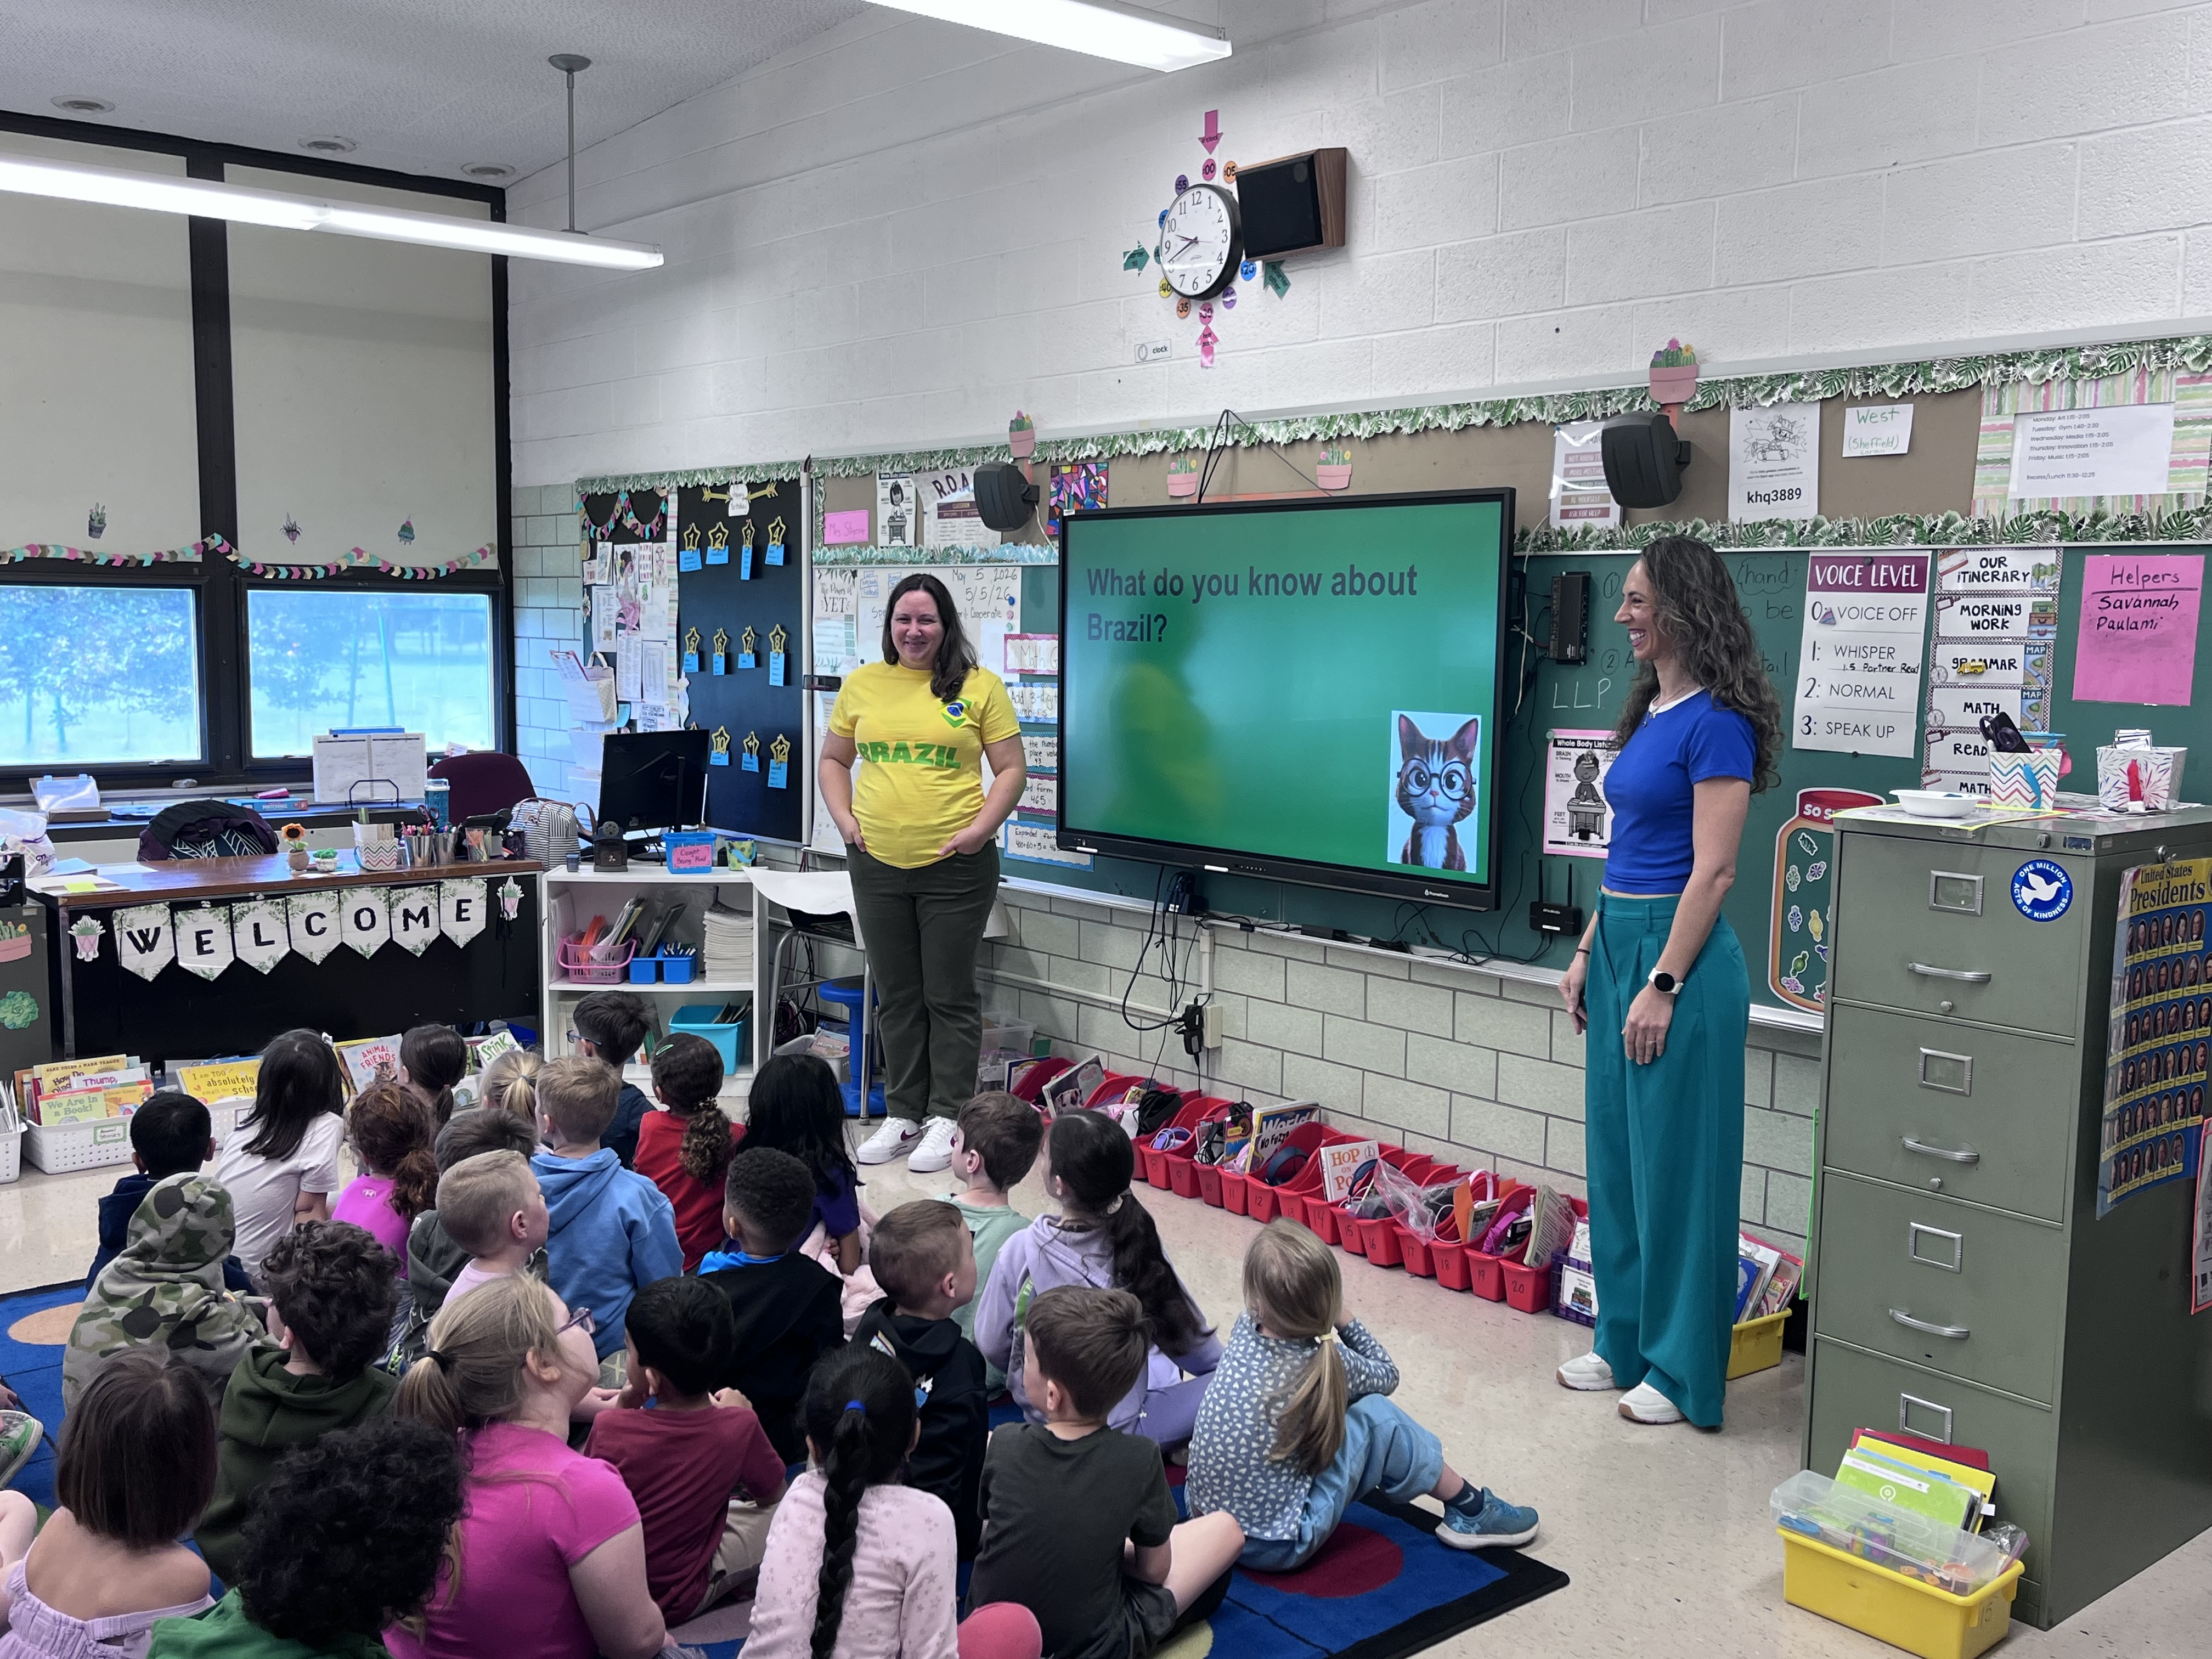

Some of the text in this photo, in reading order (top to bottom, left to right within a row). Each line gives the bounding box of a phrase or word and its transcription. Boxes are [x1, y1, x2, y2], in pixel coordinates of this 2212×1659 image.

[1203, 163, 1215, 175] :00
[1224, 166, 1236, 177] :05
[1192, 191, 1202, 206] 12
[1208, 195, 1212, 209] 1
[1179, 201, 1187, 215] 11
[1217, 209, 1223, 223] 2
[1167, 218, 1176, 233] 10
[1222, 229, 1228, 243] 3
[1164, 240, 1171, 255] 9
[1217, 251, 1223, 264] 4
[1179, 274, 1186, 288] 7
[1192, 276, 1199, 291] 6
[1206, 269, 1212, 284] 5
[1160, 283, 1171, 293] :40
[1177, 302, 1189, 313] :35
[1153, 345, 1168, 354] clock
[1857, 407, 1900, 424] West
[1849, 435, 1899, 450] (Sheffield)
[1747, 488, 1802, 505] khq3889
[689, 533, 693, 545] 1
[715, 532, 723, 546] 2
[746, 529, 751, 545] 3
[773, 526, 781, 543] 4
[1979, 556, 2008, 568] OUR
[952, 568, 984, 585] May 5
[1815, 564, 1919, 587] VOICE LEVEL
[2111, 565, 2180, 589] Helpers
[1088, 563, 1417, 604] What do you know about
[966, 584, 1011, 606] 5/5/26
[823, 596, 848, 613] YET
[1767, 599, 1793, 619] be
[2098, 594, 2179, 611] Savannah
[970, 606, 1002, 619] Cooperate
[1838, 606, 1918, 621] VOICE OFF
[1088, 613, 1168, 642] Brazil?
[1971, 618, 2010, 630] WORK
[2096, 616, 2163, 630] Paulami
[690, 637, 696, 651] 5
[718, 637, 723, 651] 6
[746, 636, 751, 650] 7
[775, 635, 780, 648] 8
[1020, 645, 1045, 668] Math
[1812, 641, 1895, 661] 1: WHISPER
[1863, 663, 1897, 673] Partner
[1901, 662, 1920, 674] Read
[1804, 677, 1895, 699] 2: NORMAL
[1012, 690, 1024, 706] Add
[1963, 702, 2000, 714] MATH
[1801, 715, 1895, 738] 3: SPEAK UP
[716, 736, 725, 751] 10
[748, 741, 755, 753] 11
[1029, 740, 1039, 748] the
[1556, 739, 1593, 749] Whole Body
[777, 744, 787, 761] 12
[856, 742, 961, 769] BRAZIL
[1029, 750, 1042, 760] place
[1959, 782, 1991, 794] MATH
[1030, 795, 1046, 805] 465
[1803, 803, 1822, 817] SO
[1015, 827, 1037, 839] Expanded
[680, 849, 701, 858] Caught
[2019, 862, 2067, 883] ONE MILLION
[2141, 865, 2193, 884] United States
[2014, 882, 2068, 919] ACTS OF KINDNESS
[2129, 878, 2206, 913] Presidents
[126, 899, 473, 956] WELCOME
[361, 1045, 390, 1059] ANIMAL
[99, 1058, 120, 1066] TEAGUE
[360, 1053, 396, 1070] FRIENDS
[52, 1074, 71, 1086] How
[82, 1074, 119, 1087] Thump,
[206, 1074, 255, 1088] absolutely
[211, 1070, 226, 1078] TOO
[46, 1101, 64, 1109] We
[67, 1098, 85, 1107] Are
[64, 1103, 93, 1116] Book!
[1330, 1148, 1361, 1167] HOP
[1229, 1188, 1234, 1200] 11
[1255, 1195, 1262, 1207] 12
[1313, 1210, 1325, 1229] 14
[1345, 1225, 1354, 1237] 15
[1369, 1237, 1376, 1250] 16
[1408, 1246, 1415, 1258] 17
[1441, 1259, 1450, 1271] 18
[1479, 1269, 1486, 1282] 19
[1512, 1280, 1525, 1294] 20
